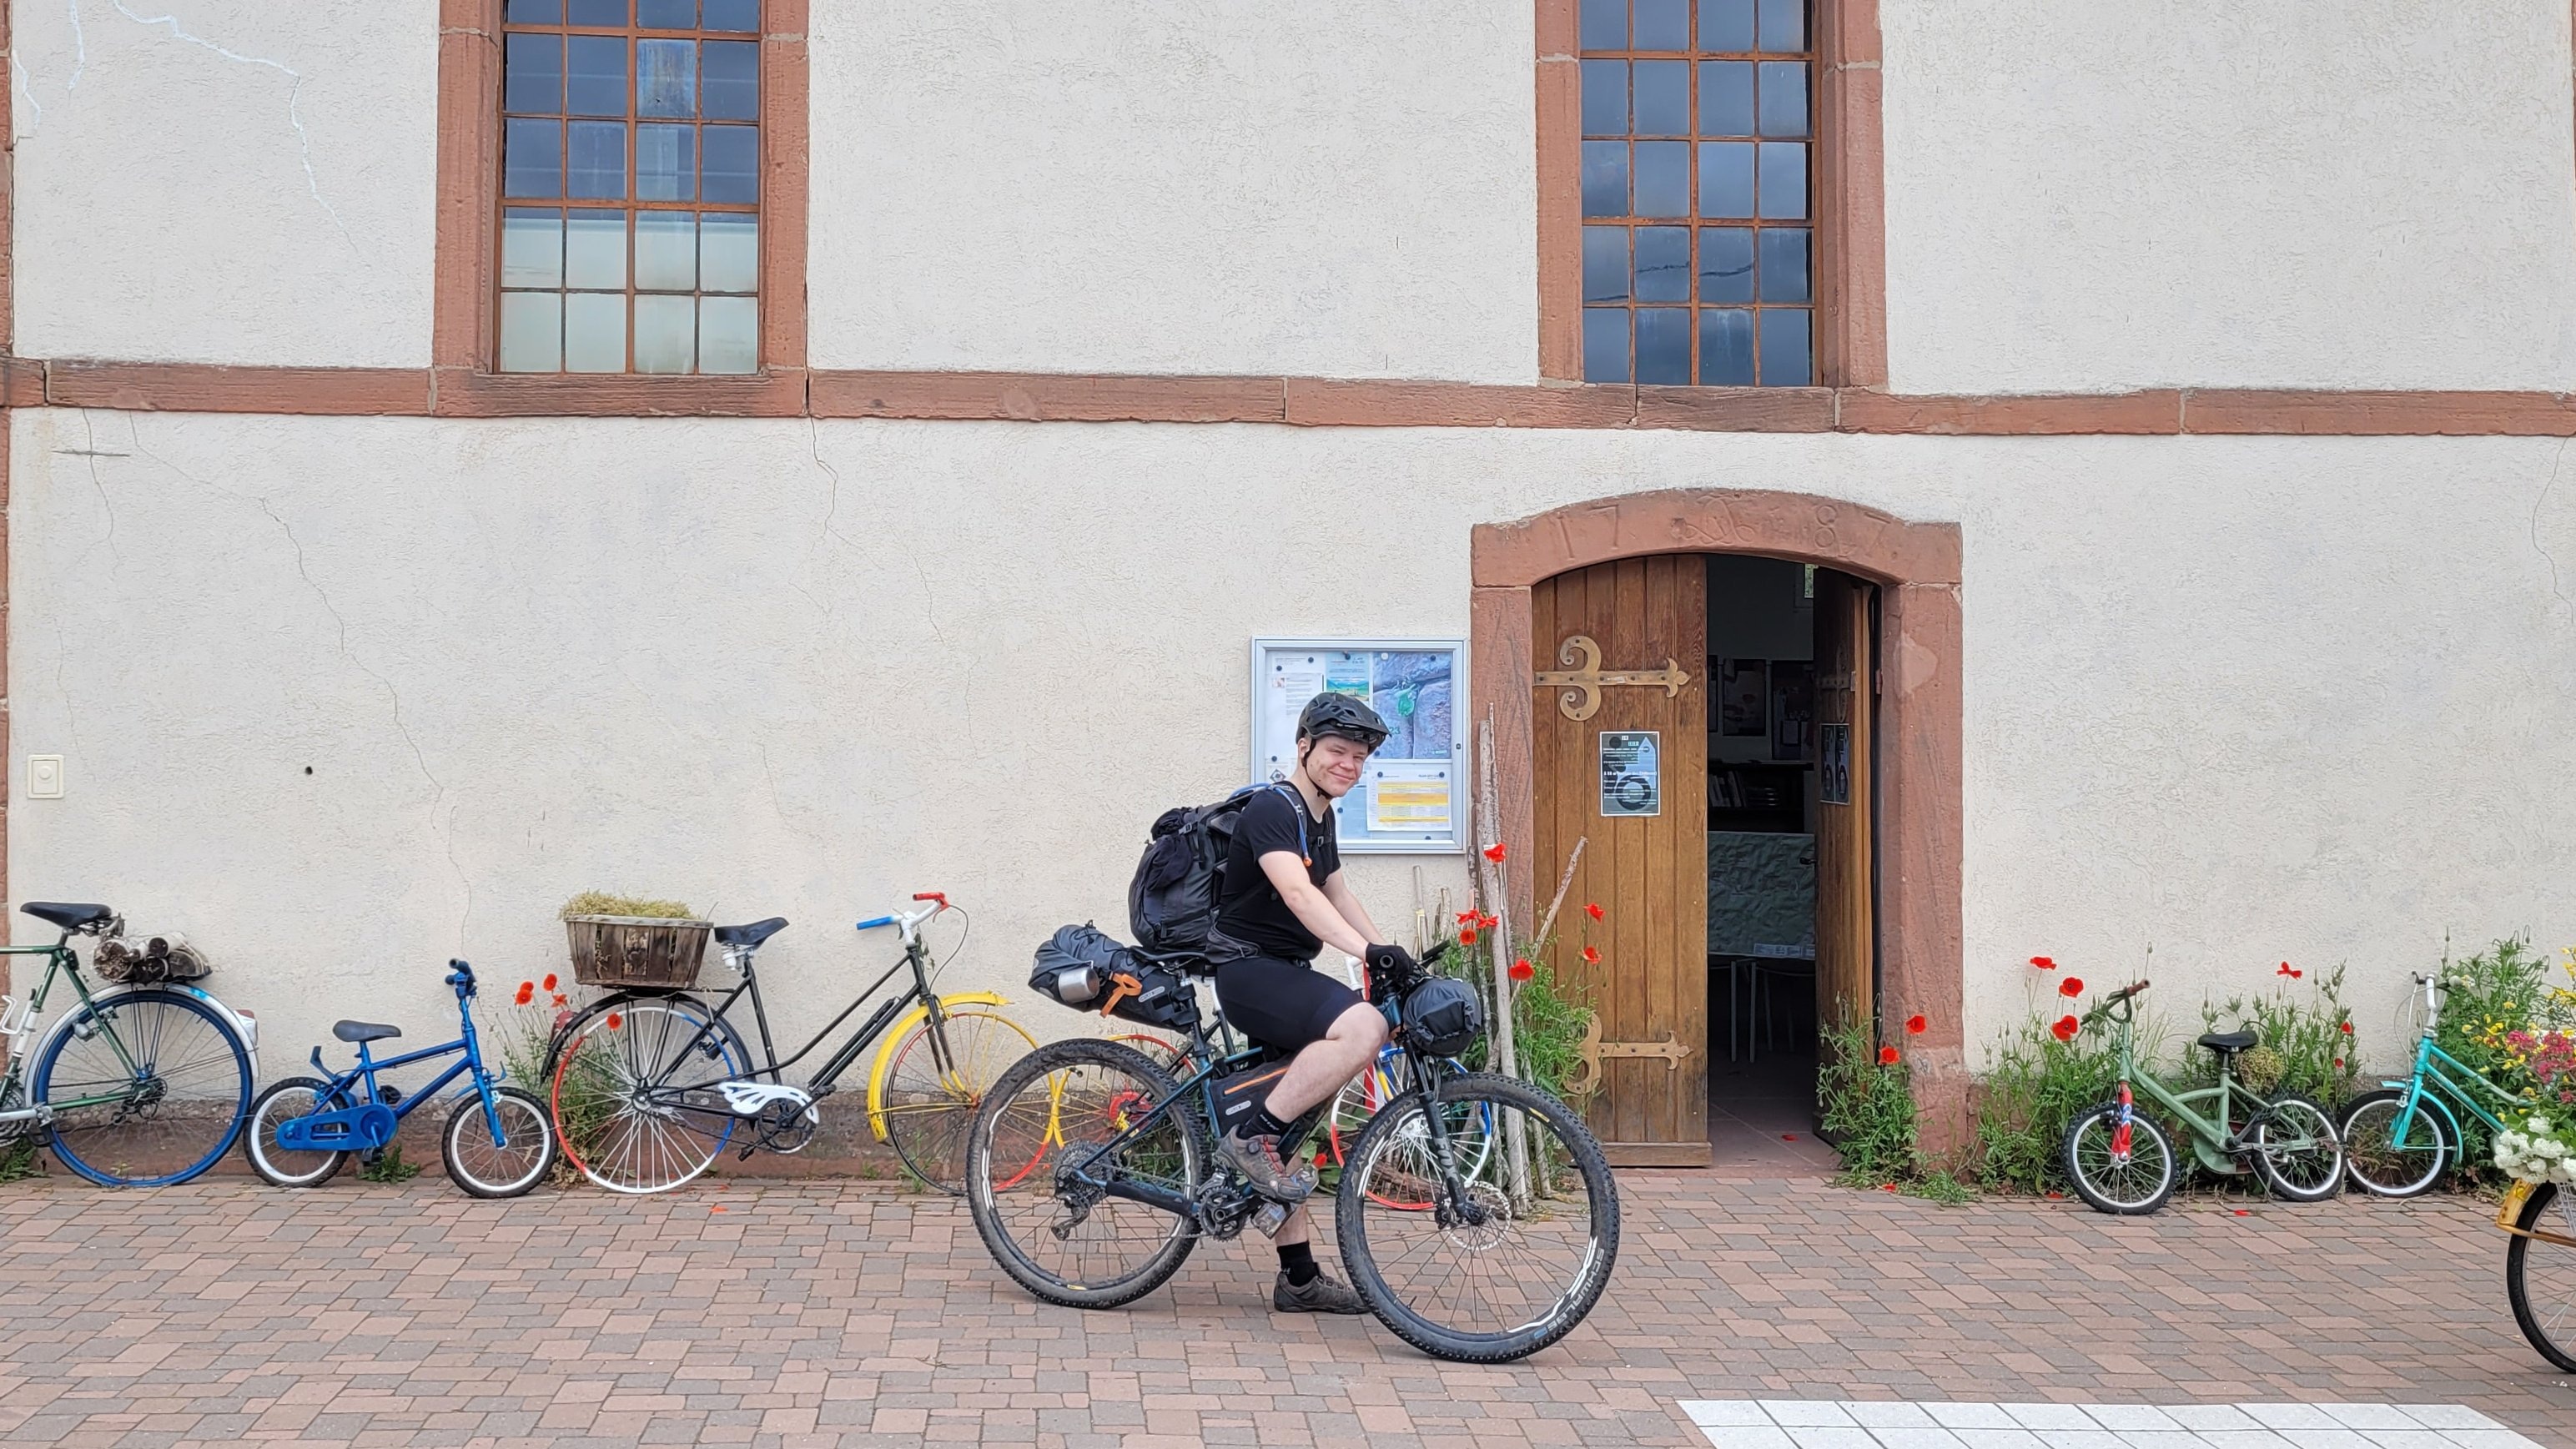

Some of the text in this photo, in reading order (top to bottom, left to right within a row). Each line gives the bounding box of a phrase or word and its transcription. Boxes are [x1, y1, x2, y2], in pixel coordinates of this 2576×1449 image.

[1356, 1136, 1377, 1166] RAY
[1434, 1137, 1460, 1184] FOX
[1547, 1247, 1605, 1332] SCHWALBE
